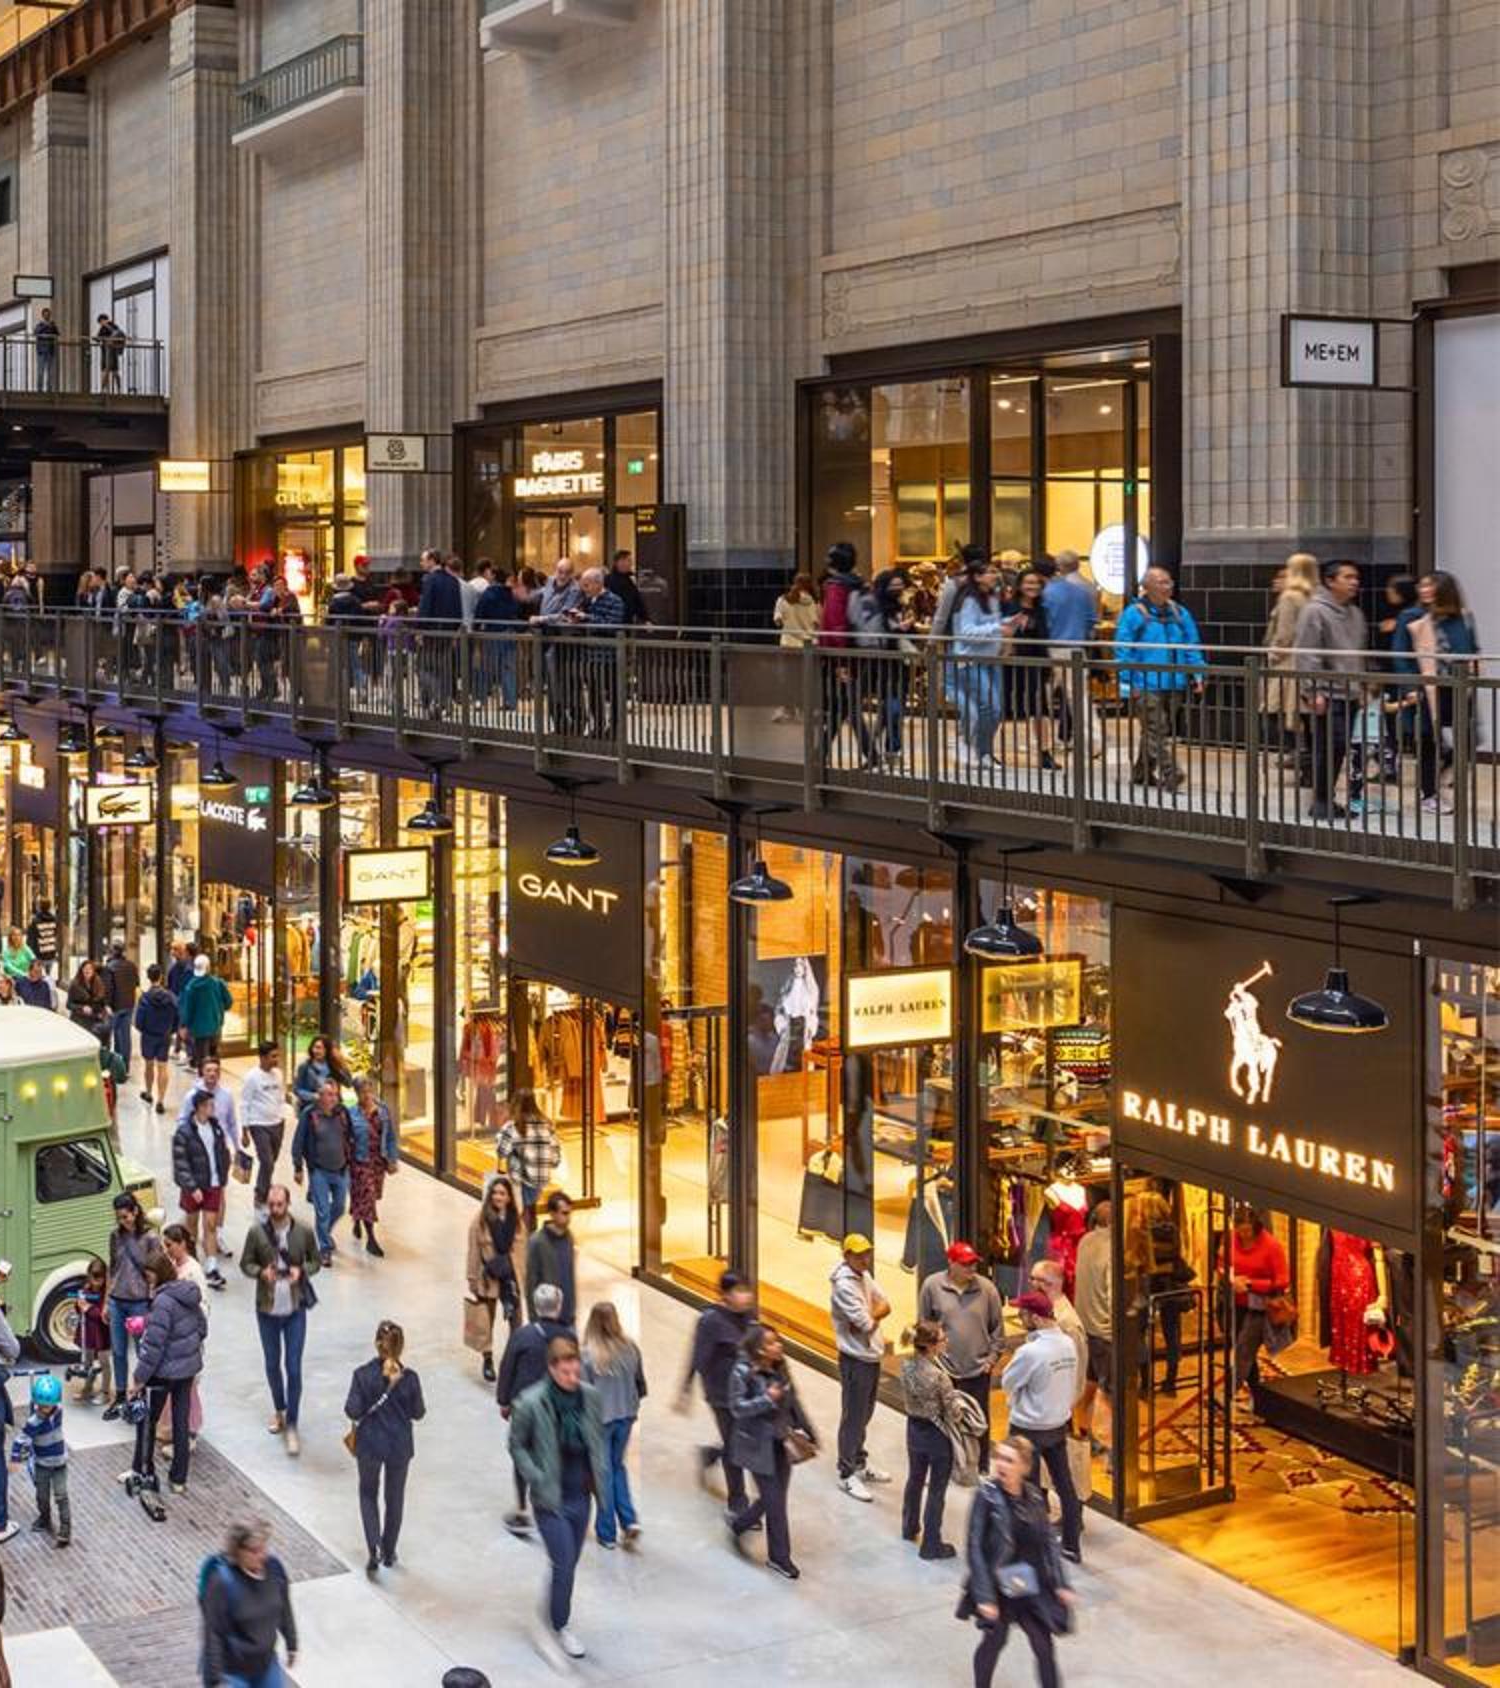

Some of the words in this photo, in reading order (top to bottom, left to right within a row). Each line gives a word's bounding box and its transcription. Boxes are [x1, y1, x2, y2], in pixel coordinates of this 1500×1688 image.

[1305, 342, 1359, 362] ME+EM
[532, 450, 584, 473] PARIS
[514, 472, 605, 497] BAGUETTE
[200, 799, 245, 826] LACOSTE
[357, 868, 419, 882] GANT
[518, 873, 619, 915] GANT
[901, 997, 947, 1013] LAUREN
[1122, 1090, 1231, 1145] RALPH
[1247, 1124, 1395, 1192] LAUREN
